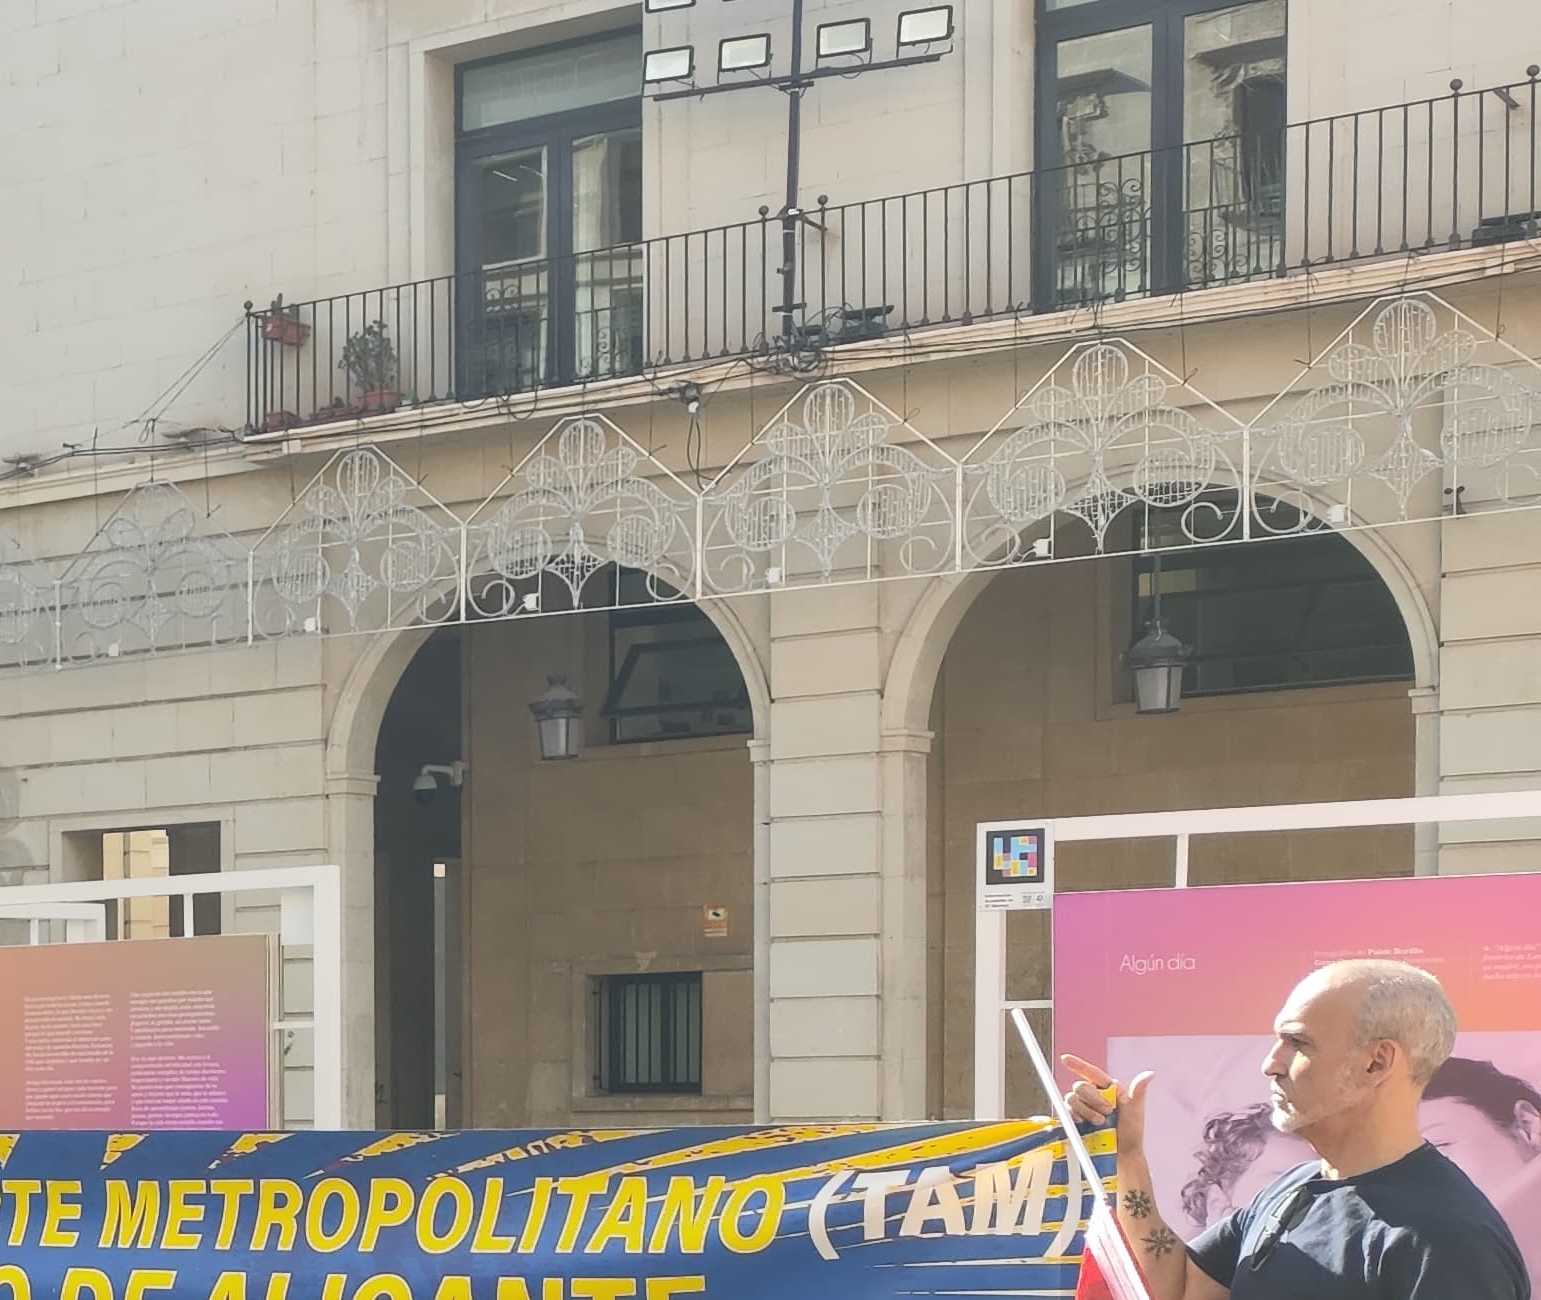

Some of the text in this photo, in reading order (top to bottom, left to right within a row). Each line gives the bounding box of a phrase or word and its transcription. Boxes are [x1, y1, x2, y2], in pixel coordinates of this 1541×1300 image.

[1119, 951, 1196, 974] Algún día
[97, 1174, 785, 1255] METROPOLITANO
[808, 1145, 1083, 1261] (TAM)
